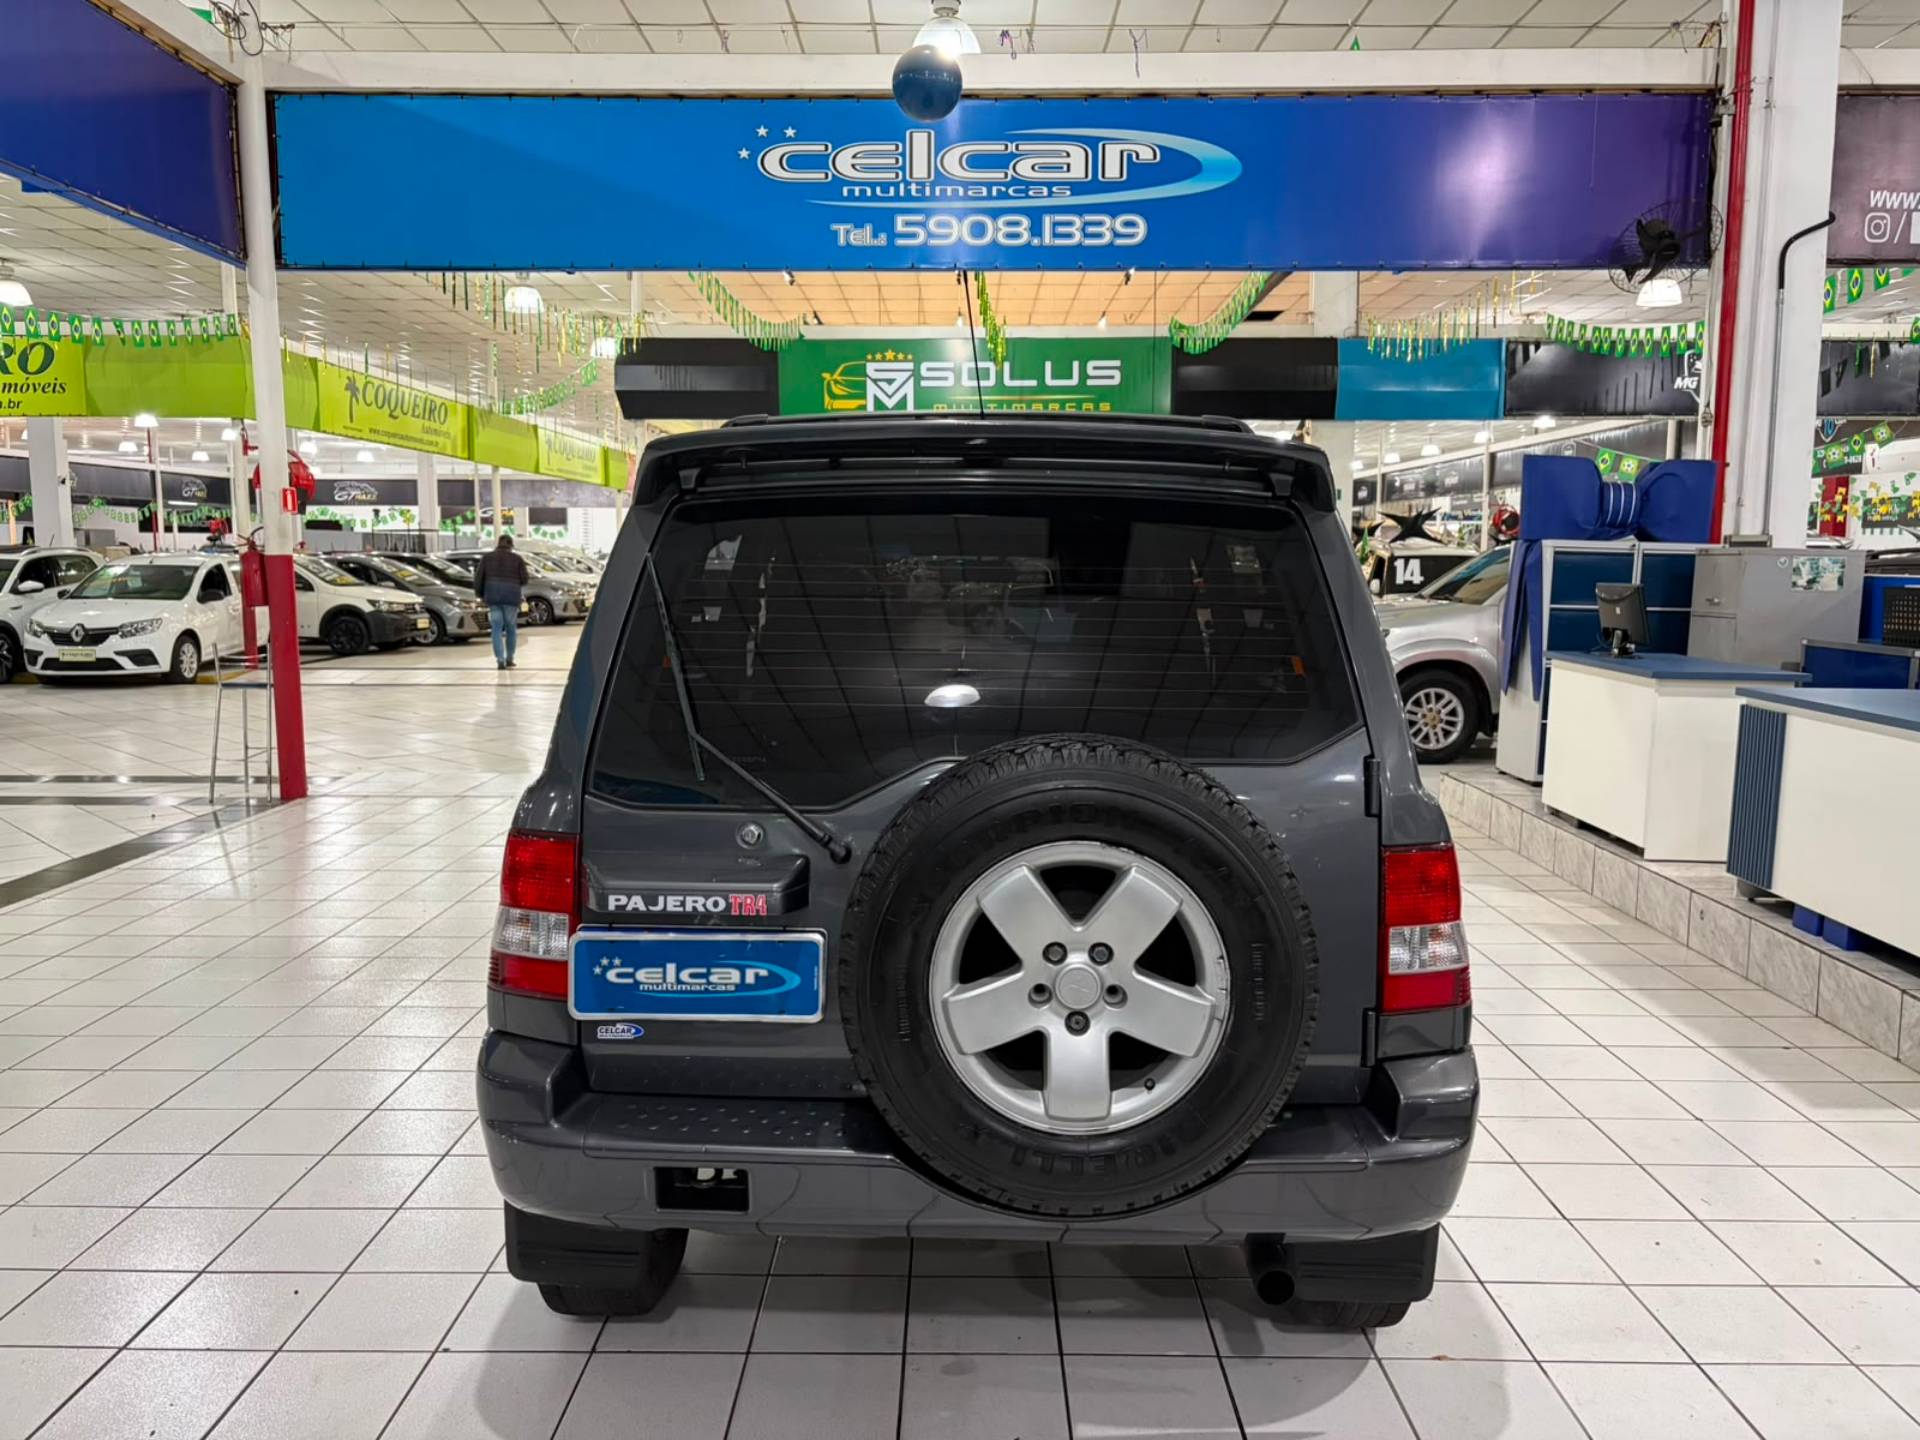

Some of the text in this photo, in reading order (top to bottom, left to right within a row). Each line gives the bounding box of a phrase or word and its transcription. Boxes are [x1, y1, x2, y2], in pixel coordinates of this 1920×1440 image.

[756, 128, 1161, 182] celcar
[841, 181, 1071, 198] multimarcas
[893, 212, 1148, 247] 5908.1339
[920, 359, 1122, 387] SOLUS
[361, 381, 449, 425] COQUEIRO
[1393, 558, 1424, 585] 14
[607, 894, 768, 916] PAJERO TR4
[606, 963, 769, 985] celcar
[639, 982, 736, 992] multimarcas
